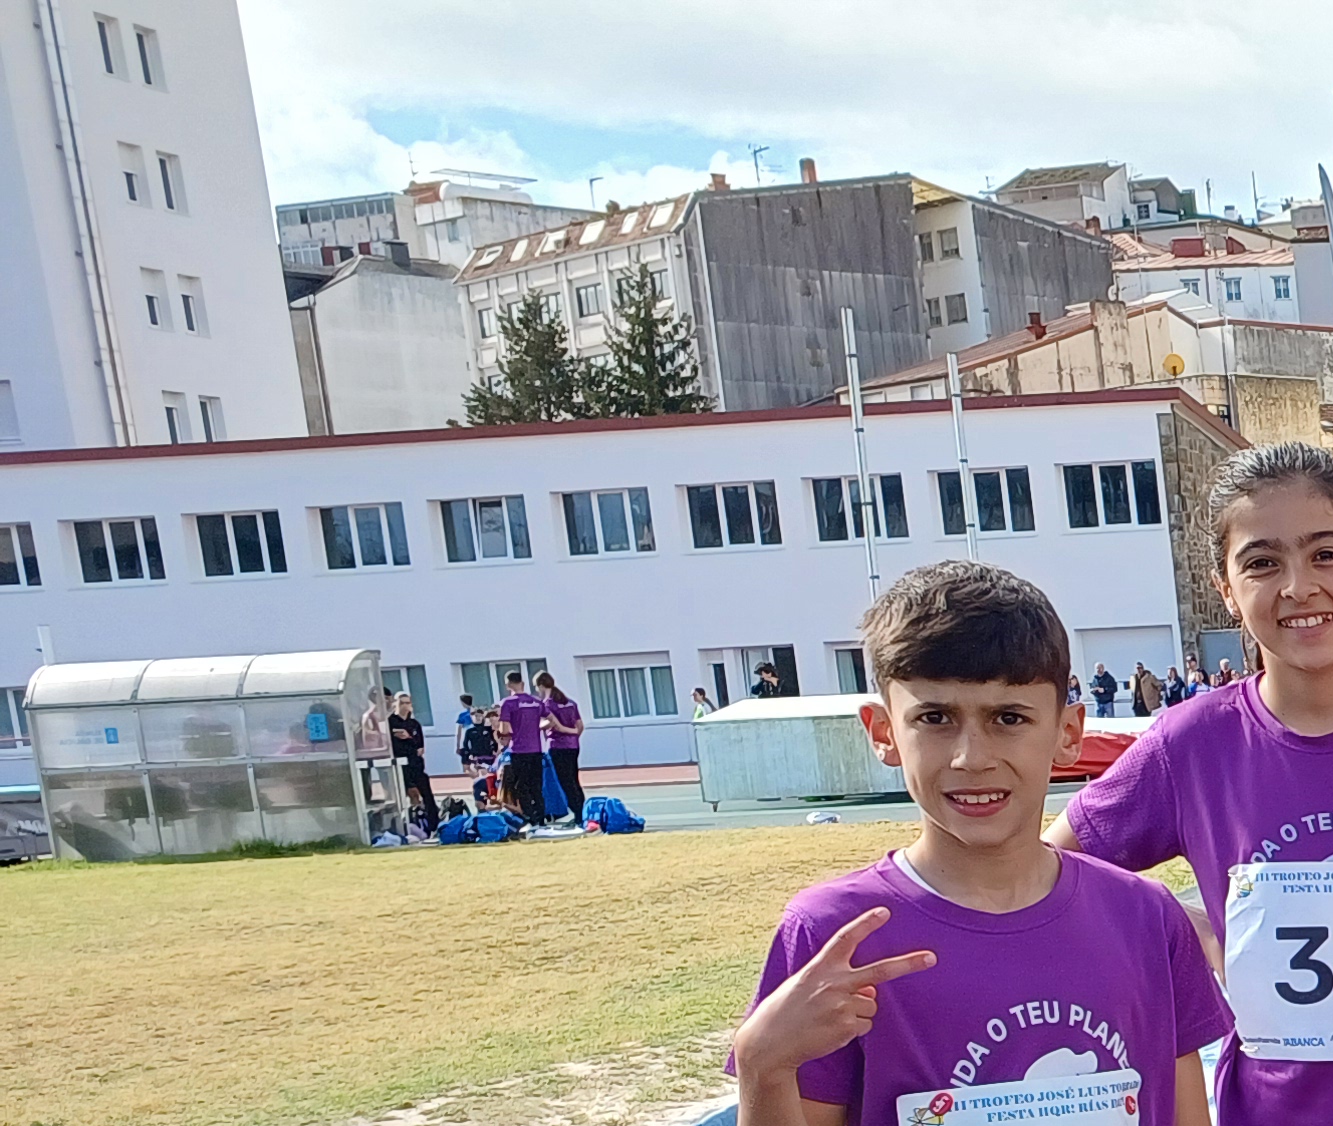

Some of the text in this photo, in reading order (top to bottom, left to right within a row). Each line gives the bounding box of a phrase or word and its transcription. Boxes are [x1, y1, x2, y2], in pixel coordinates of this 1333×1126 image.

[1280, 823, 1297, 842] O
[1271, 871, 1321, 881] TROFEO
[1283, 884, 1321, 894] FESTA
[950, 1000, 1130, 1088] IDA O TEU PLANE
[1283, 1037, 1325, 1047] ABANCA
[970, 1094, 1034, 1109] TROFEO
[1037, 1087, 1075, 1104] JOSÉ
[1078, 1085, 1108, 1098] LUIS
[987, 1109, 1036, 1122] FESTA
[1079, 1099, 1108, 1112] RÍAS
